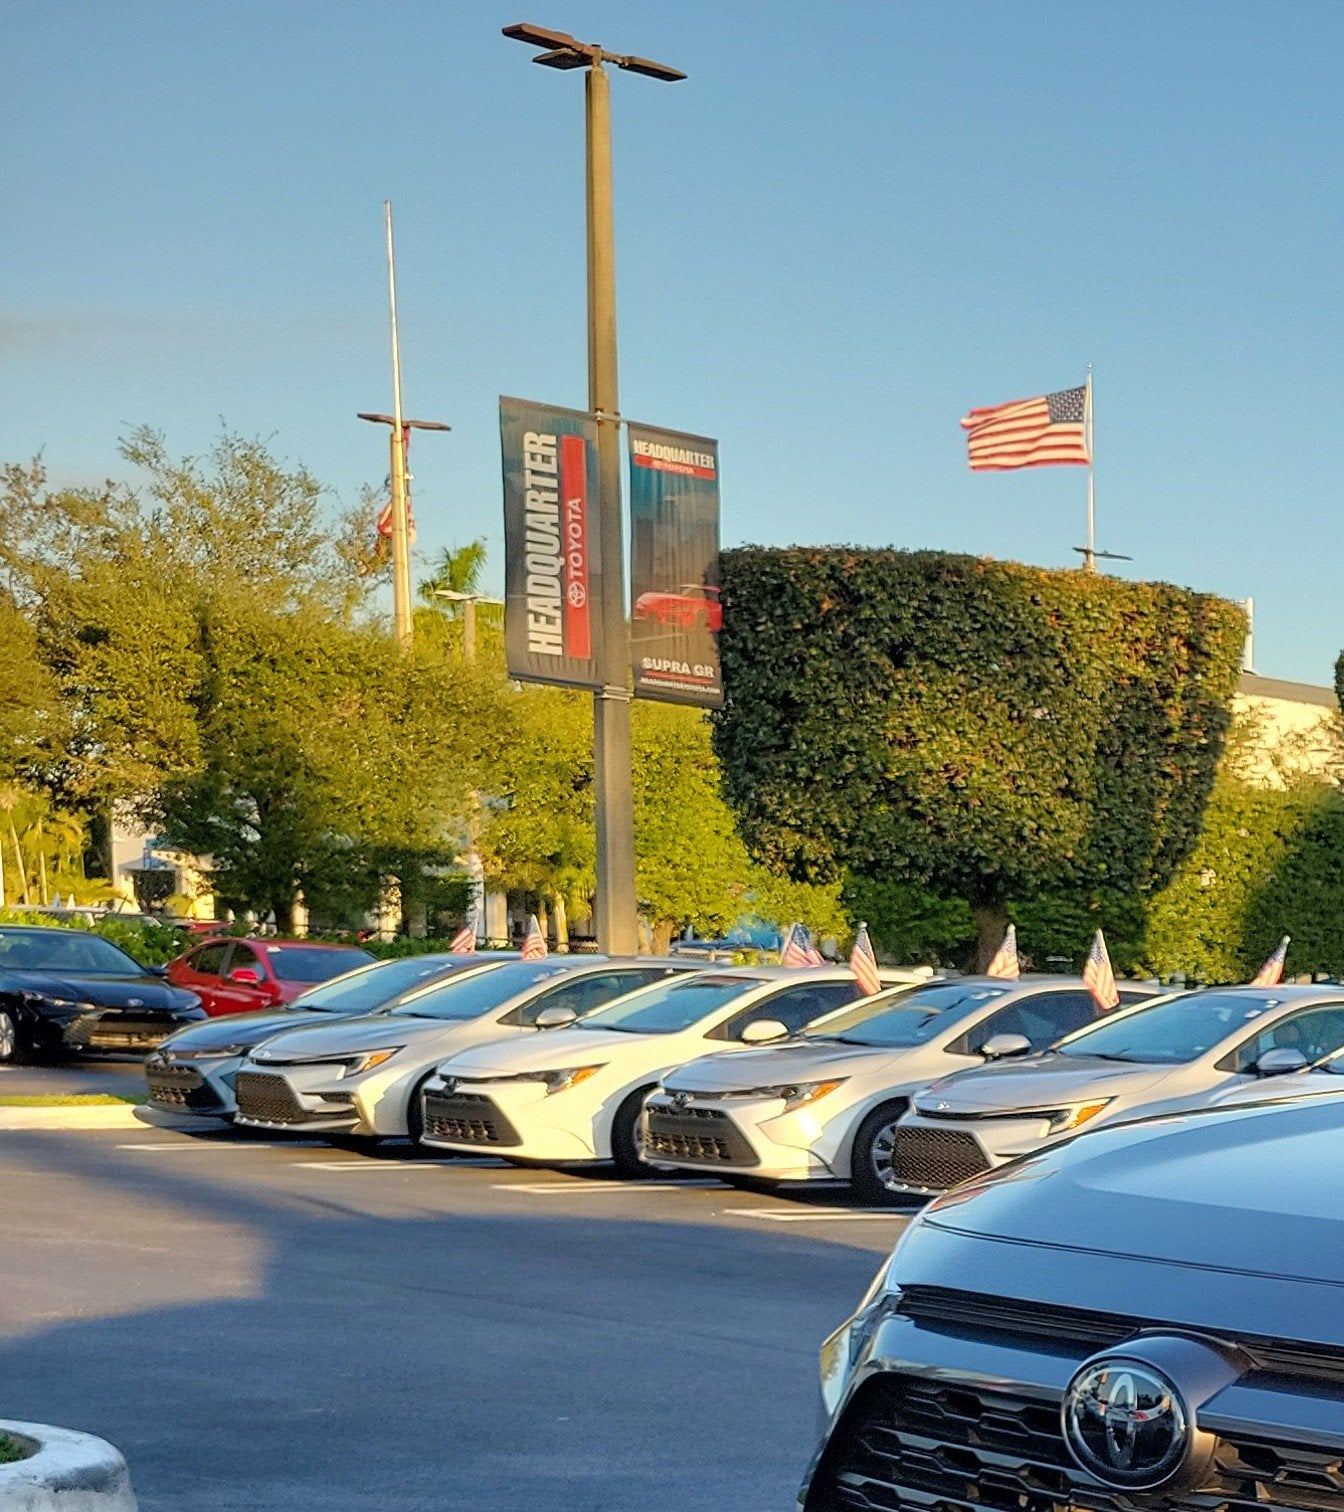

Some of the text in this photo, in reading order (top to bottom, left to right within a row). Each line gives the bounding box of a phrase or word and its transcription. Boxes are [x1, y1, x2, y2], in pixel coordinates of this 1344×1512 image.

[633, 439, 715, 469] HEADQUARTER
[523, 431, 565, 656] HEADQUARTER
[566, 498, 584, 579] TOYOTA
[641, 657, 714, 678] SUPRA GR
